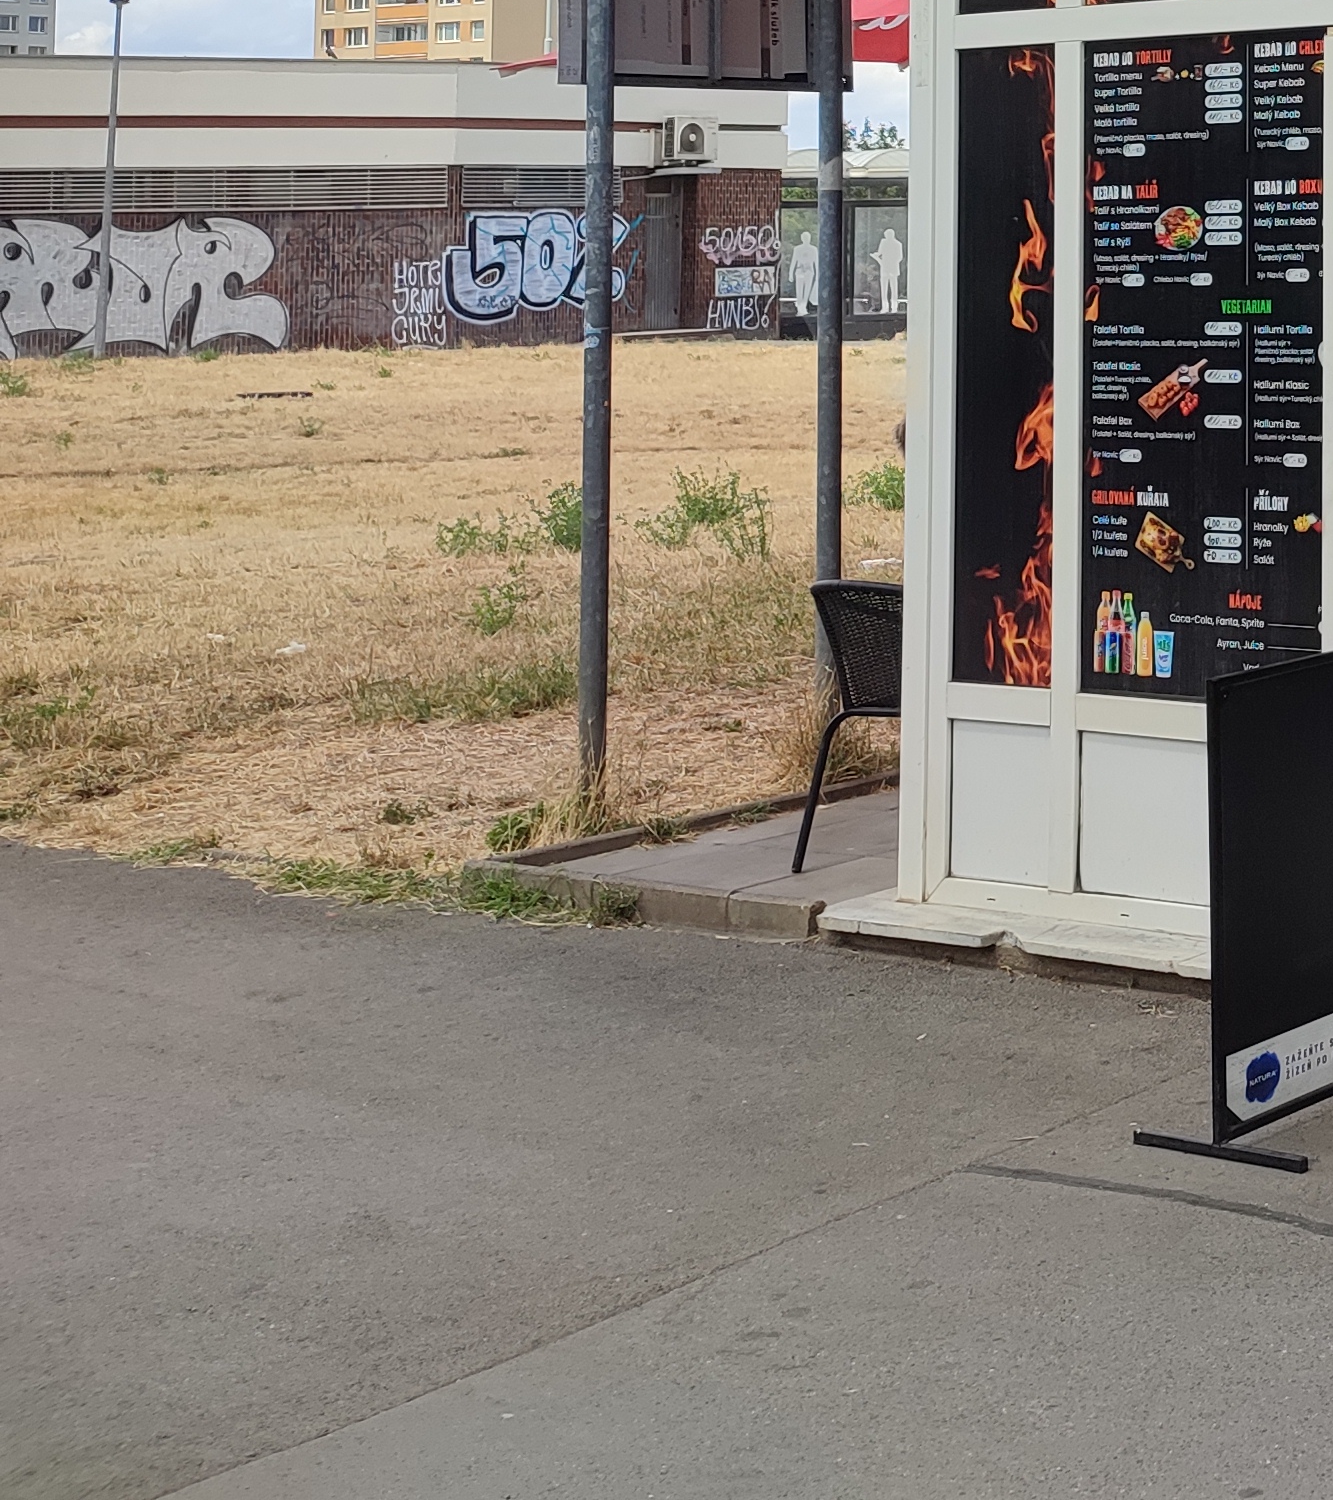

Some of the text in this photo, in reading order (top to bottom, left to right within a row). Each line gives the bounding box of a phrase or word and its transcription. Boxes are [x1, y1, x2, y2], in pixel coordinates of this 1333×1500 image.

[1254, 42, 1282, 58] KEBAB
[1285, 41, 1296, 56] DO
[1093, 49, 1172, 67] KEBAB DO TORTILLY
[1093, 185, 1119, 200] KEBAB
[1121, 185, 1133, 199] NA
[1254, 180, 1282, 195] KEBAB
[1221, 299, 1272, 314] VEGETARIAN
[1137, 485, 1169, 507] KUŘATA
[1228, 519, 1238, 527] Kč
[1228, 536, 1238, 545] Kč
[1228, 552, 1238, 561] Kč
[1228, 589, 1263, 611] NÁPOJE
[1316, 1054, 1328, 1068] PO
[1250, 1069, 1277, 1087] NATURA
